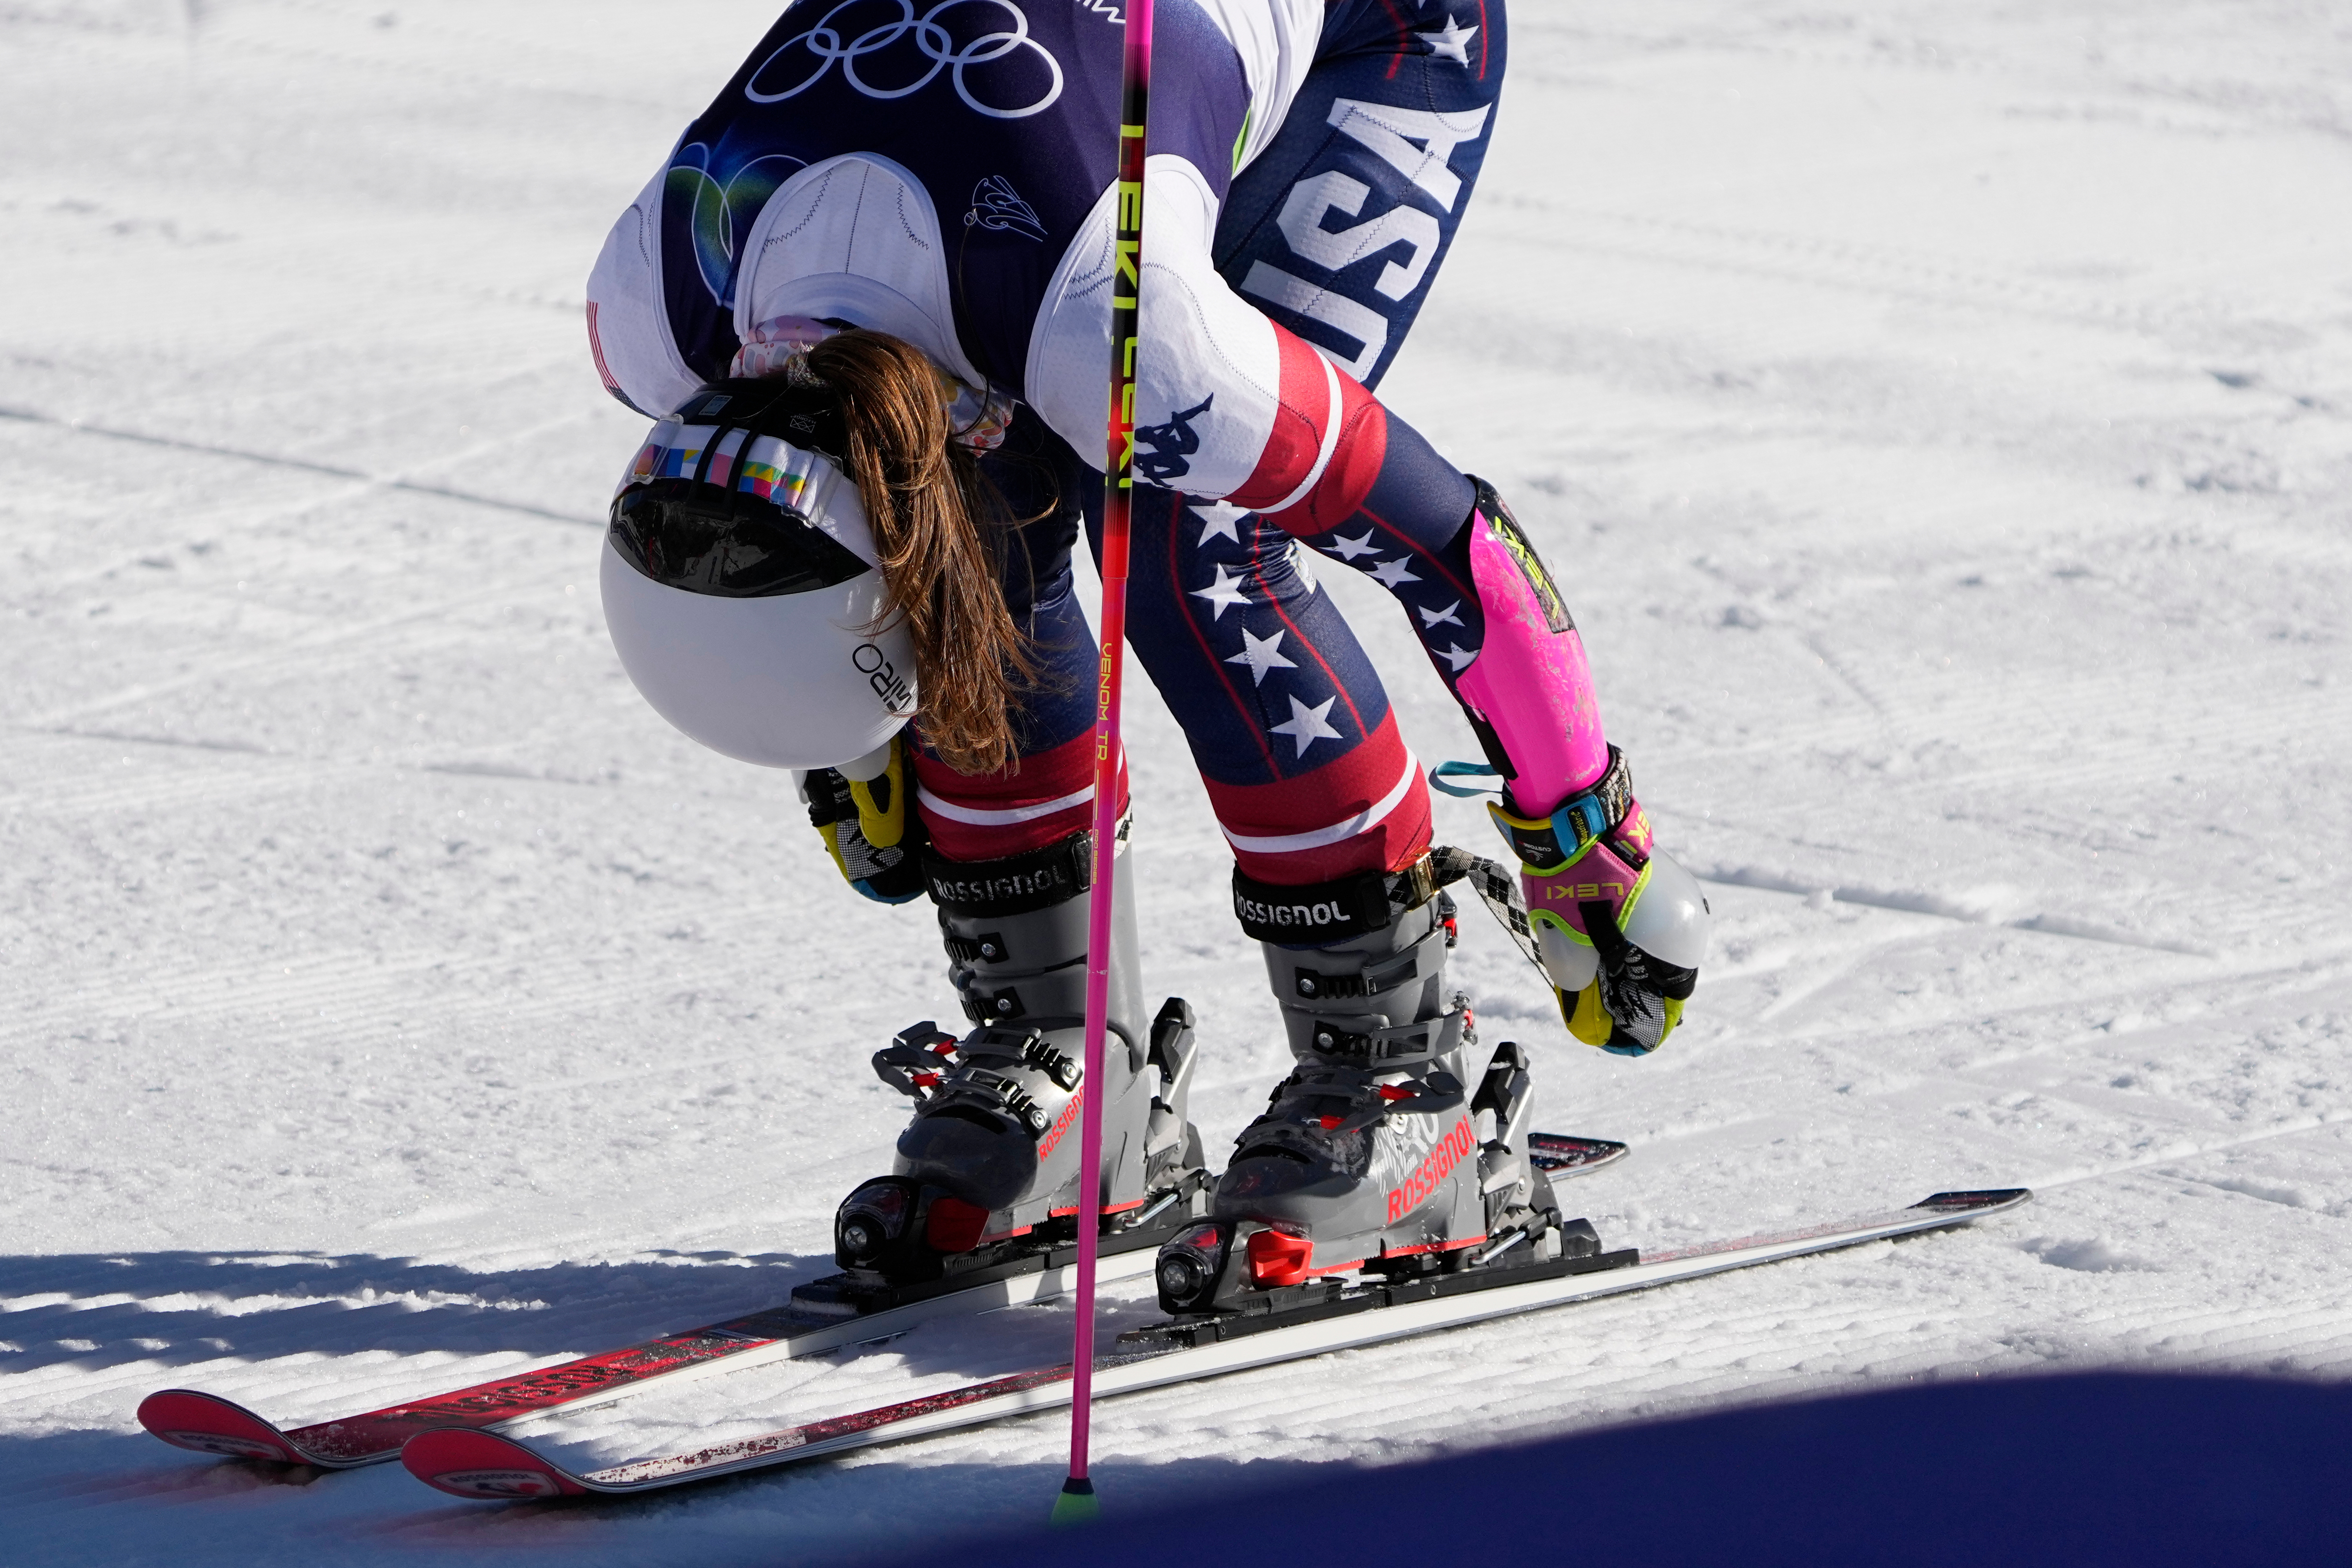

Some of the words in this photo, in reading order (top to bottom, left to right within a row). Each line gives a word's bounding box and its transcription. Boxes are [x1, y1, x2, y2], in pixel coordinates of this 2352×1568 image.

[1113, 124, 1144, 310] LEKI
[1240, 97, 1492, 382] USA
[1099, 643, 1112, 721] VENOM
[1097, 730, 1108, 761] TR
[1620, 812, 1652, 854] EKI
[1547, 882, 1624, 900] LEKI
[1038, 1085, 1084, 1162] ROSSIGN
[1388, 1114, 1476, 1224] ROSSIGNOL
